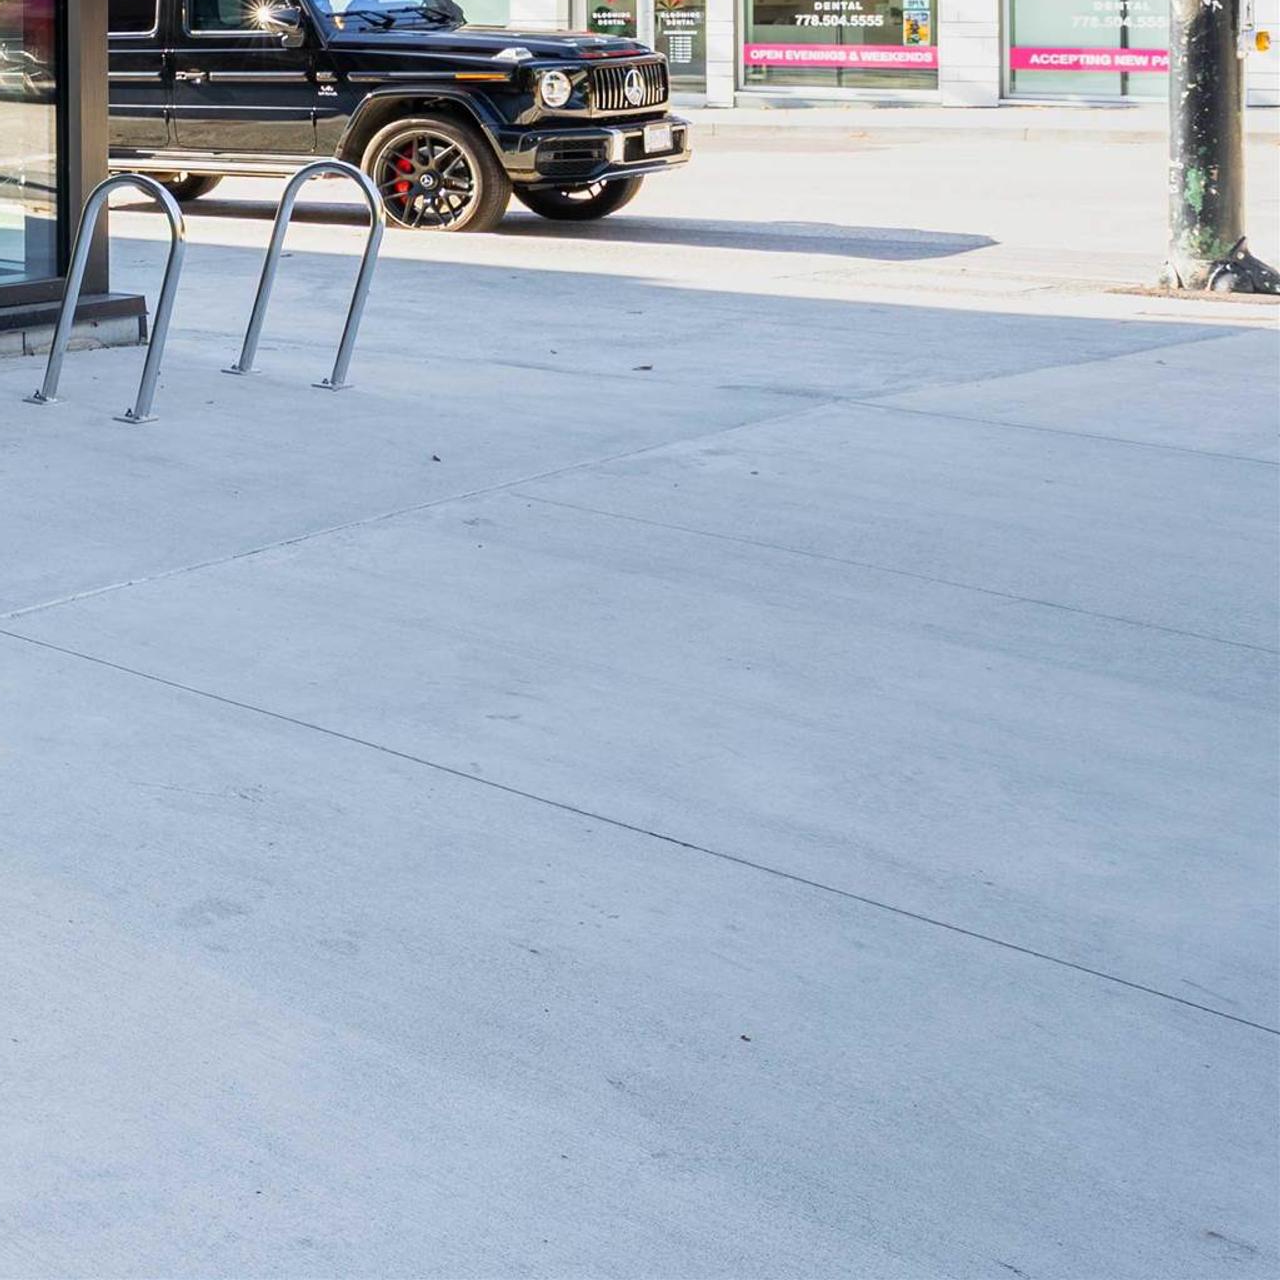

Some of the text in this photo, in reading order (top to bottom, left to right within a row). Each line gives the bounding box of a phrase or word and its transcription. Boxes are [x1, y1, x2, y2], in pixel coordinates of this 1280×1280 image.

[814, 1, 863, 11] DENTAL
[794, 14, 884, 27] 778.504.5555
[750, 49, 932, 63] OPEN EVENINGS & WEEKENDS
[1030, 53, 1112, 65] ACCEPTING
[1115, 55, 1150, 66] NEW
